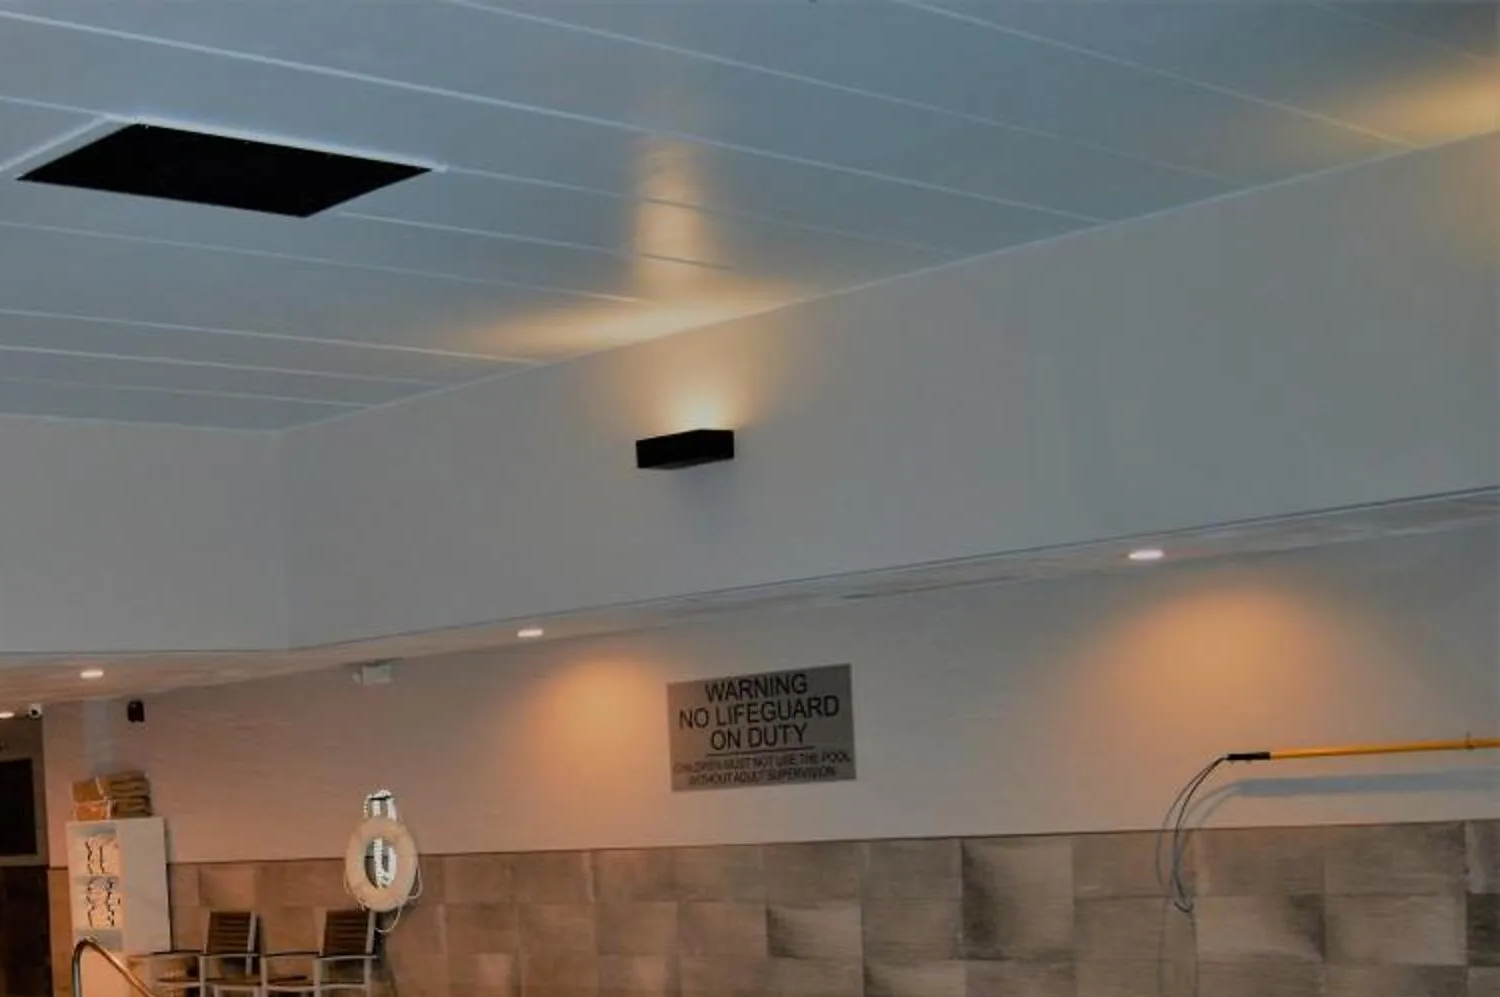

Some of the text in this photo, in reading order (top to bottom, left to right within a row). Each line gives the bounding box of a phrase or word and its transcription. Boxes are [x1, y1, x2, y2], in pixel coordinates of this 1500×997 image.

[704, 673, 808, 704] WARNING
[678, 694, 840, 730] NO LIFEGUARD
[710, 721, 809, 751] ON DUTY
[820, 750, 851, 764] POOL
